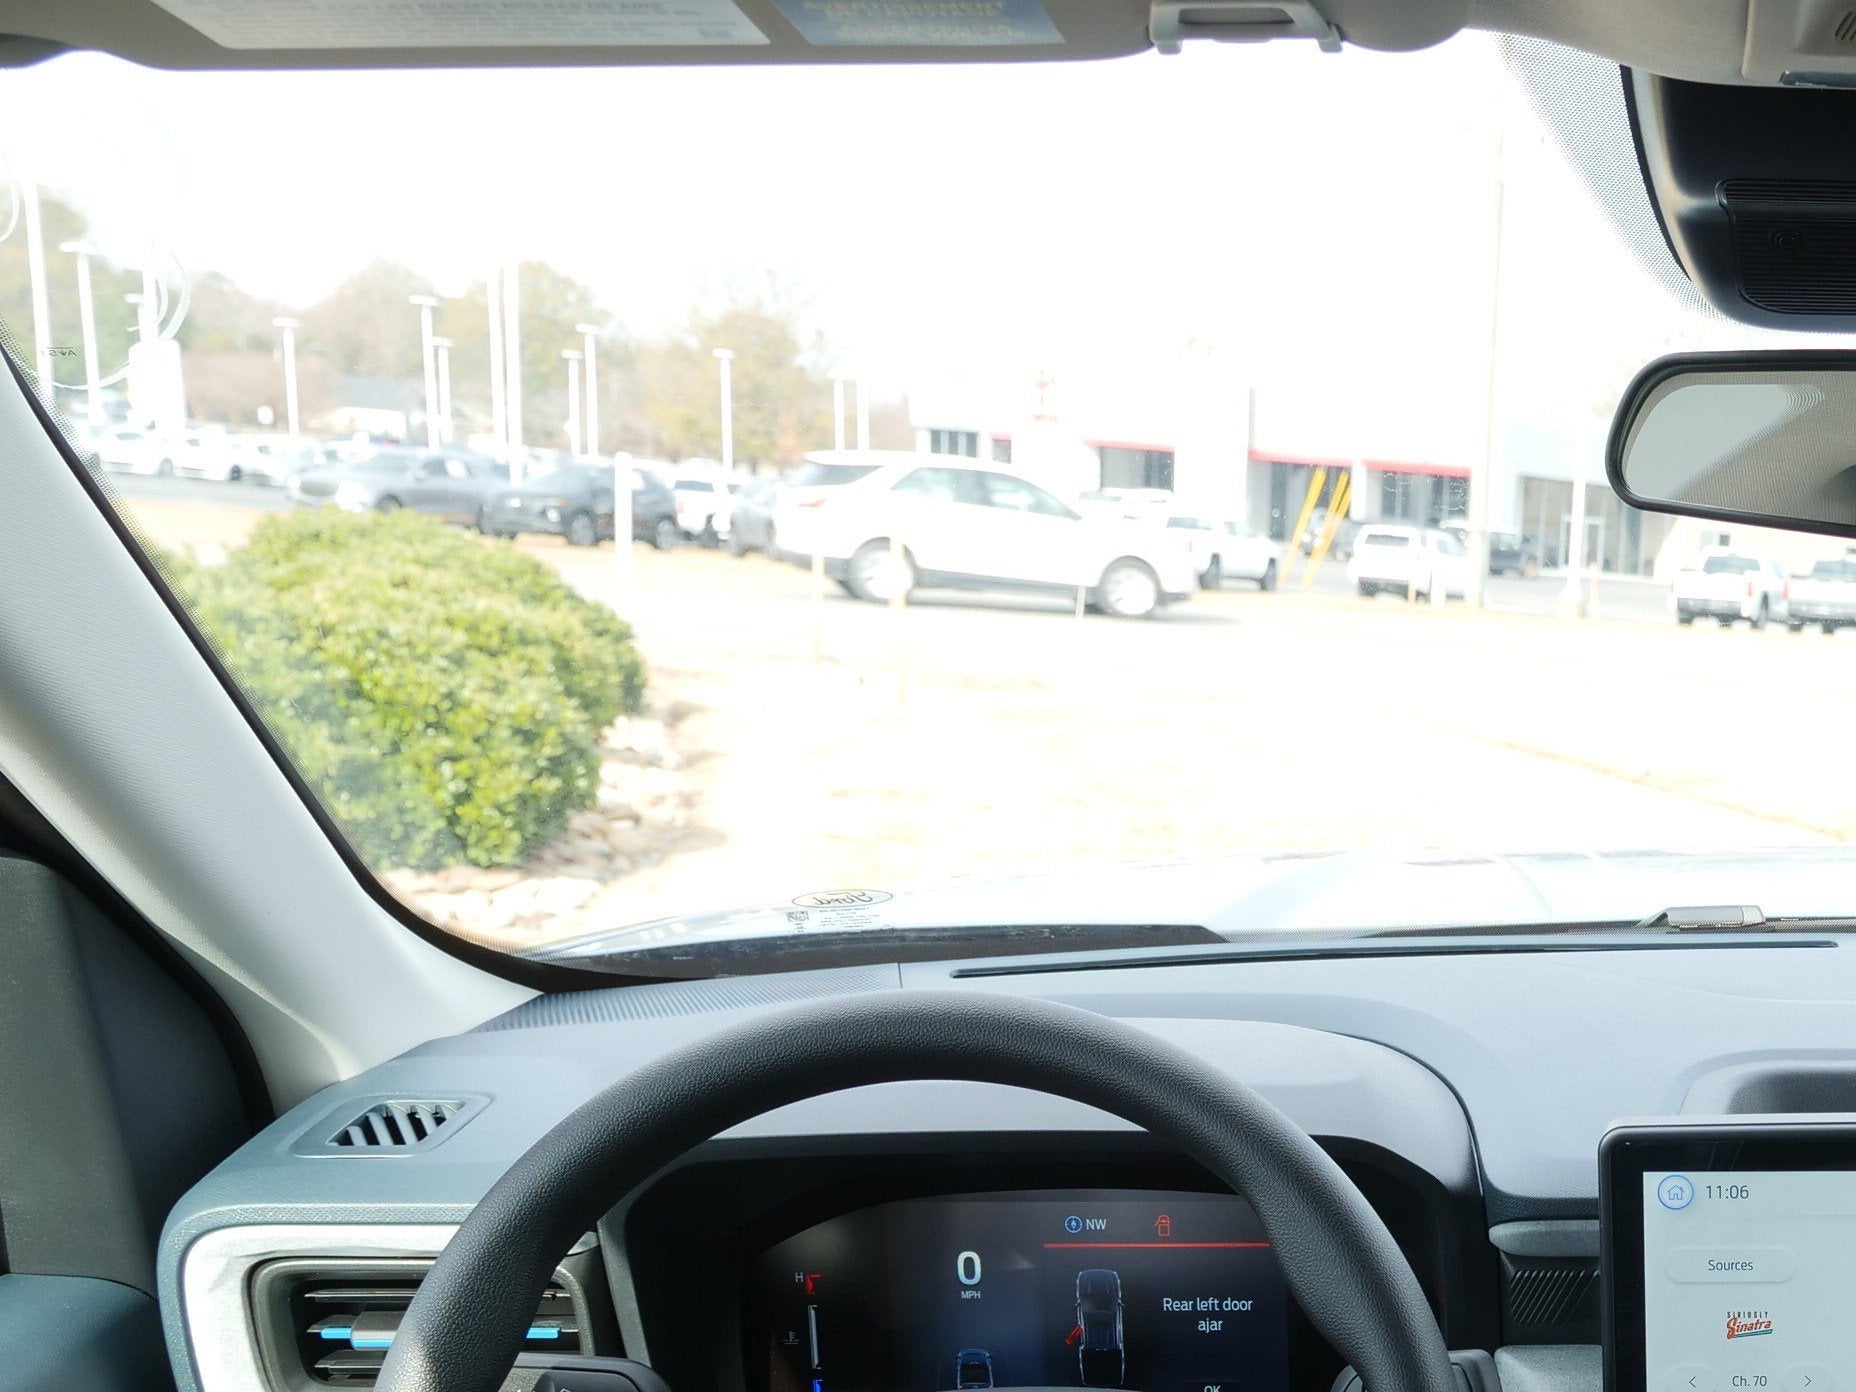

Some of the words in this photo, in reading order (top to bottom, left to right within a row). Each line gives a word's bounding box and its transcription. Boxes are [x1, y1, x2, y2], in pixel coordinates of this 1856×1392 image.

[1706, 1185, 1750, 1199] 11:06
[1086, 1219, 1107, 1230] NW
[957, 1250, 982, 1285] 0
[1708, 1259, 1754, 1272] Sources
[795, 1272, 804, 1282] H
[961, 1290, 981, 1299] MPH
[1163, 1298, 1193, 1312] Rear
[1197, 1297, 1219, 1312] left
[1222, 1297, 1253, 1312] door
[1197, 1319, 1223, 1333] ajar
[1726, 1317, 1772, 1340] Sinatra
[1732, 1375, 1750, 1387] Ch.
[1753, 1375, 1768, 1387] 70
